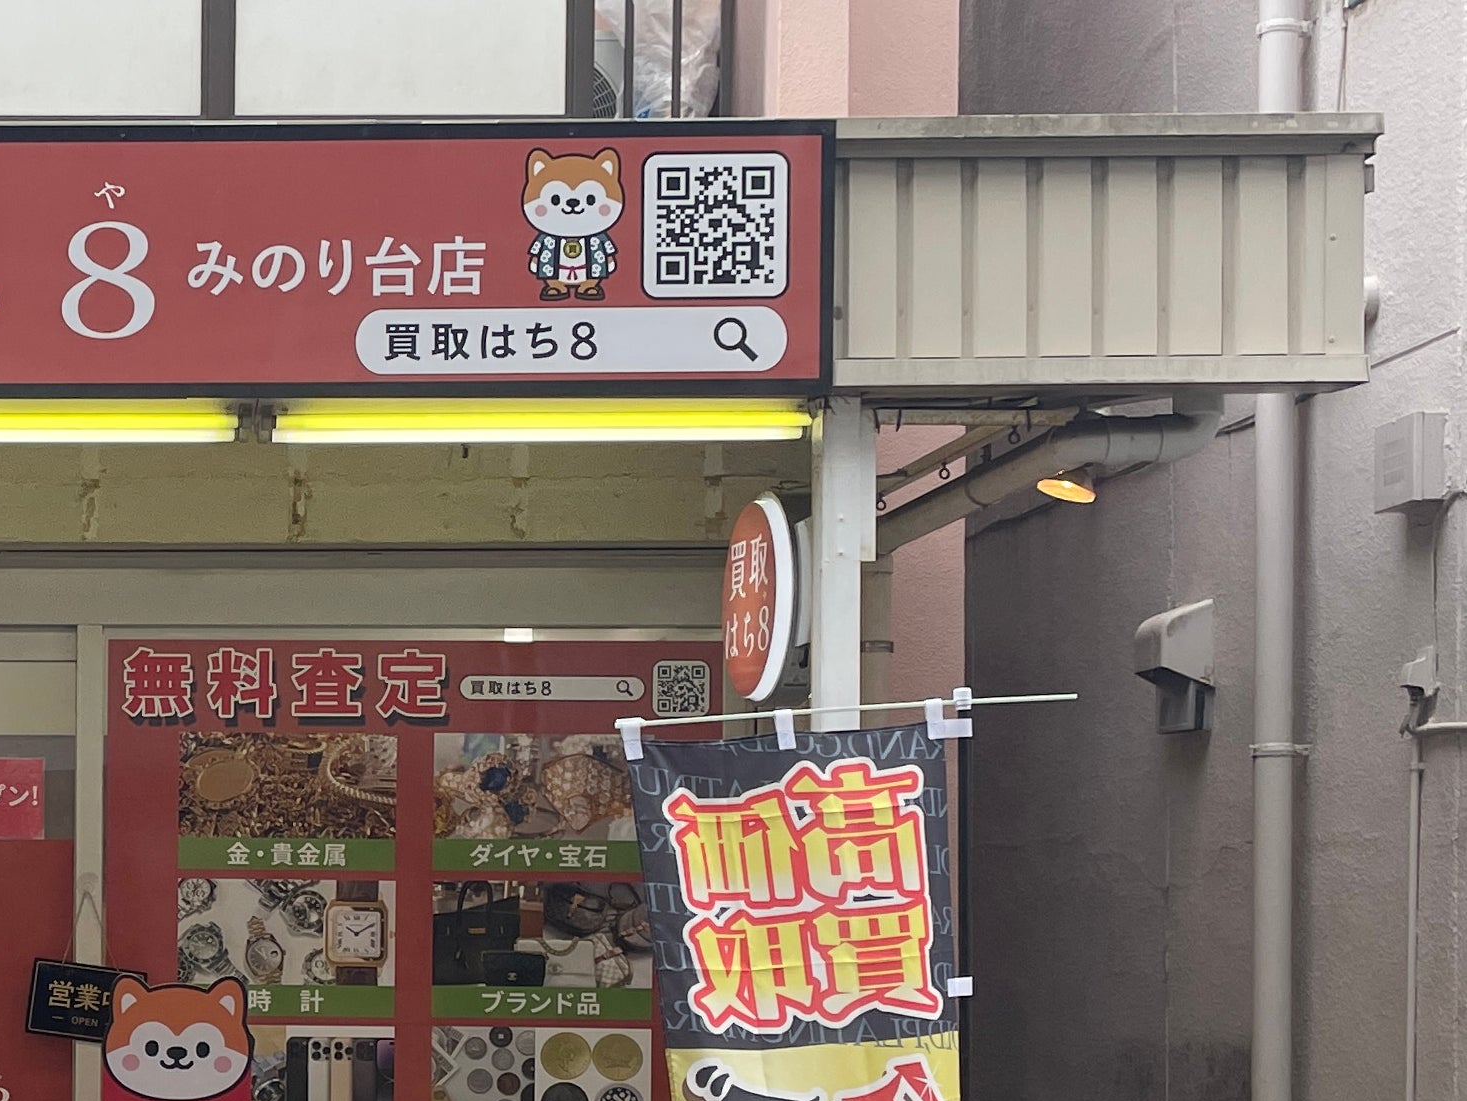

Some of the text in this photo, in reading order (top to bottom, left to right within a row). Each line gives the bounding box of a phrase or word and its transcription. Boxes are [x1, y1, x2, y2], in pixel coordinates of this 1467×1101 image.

[187, 236, 487, 297] みのり台店
[384, 321, 598, 361] 買取はち8
[729, 533, 768, 601] 買取
[725, 606, 769, 659] はち8
[122, 646, 447, 719] 無料査定
[470, 679, 553, 697] 買取はち8
[226, 842, 347, 868] 金・貴金属
[470, 844, 608, 869] ダイヤ・宝石
[481, 990, 601, 1015] ブランド品
[71, 1016, 98, 1027] OPEN
